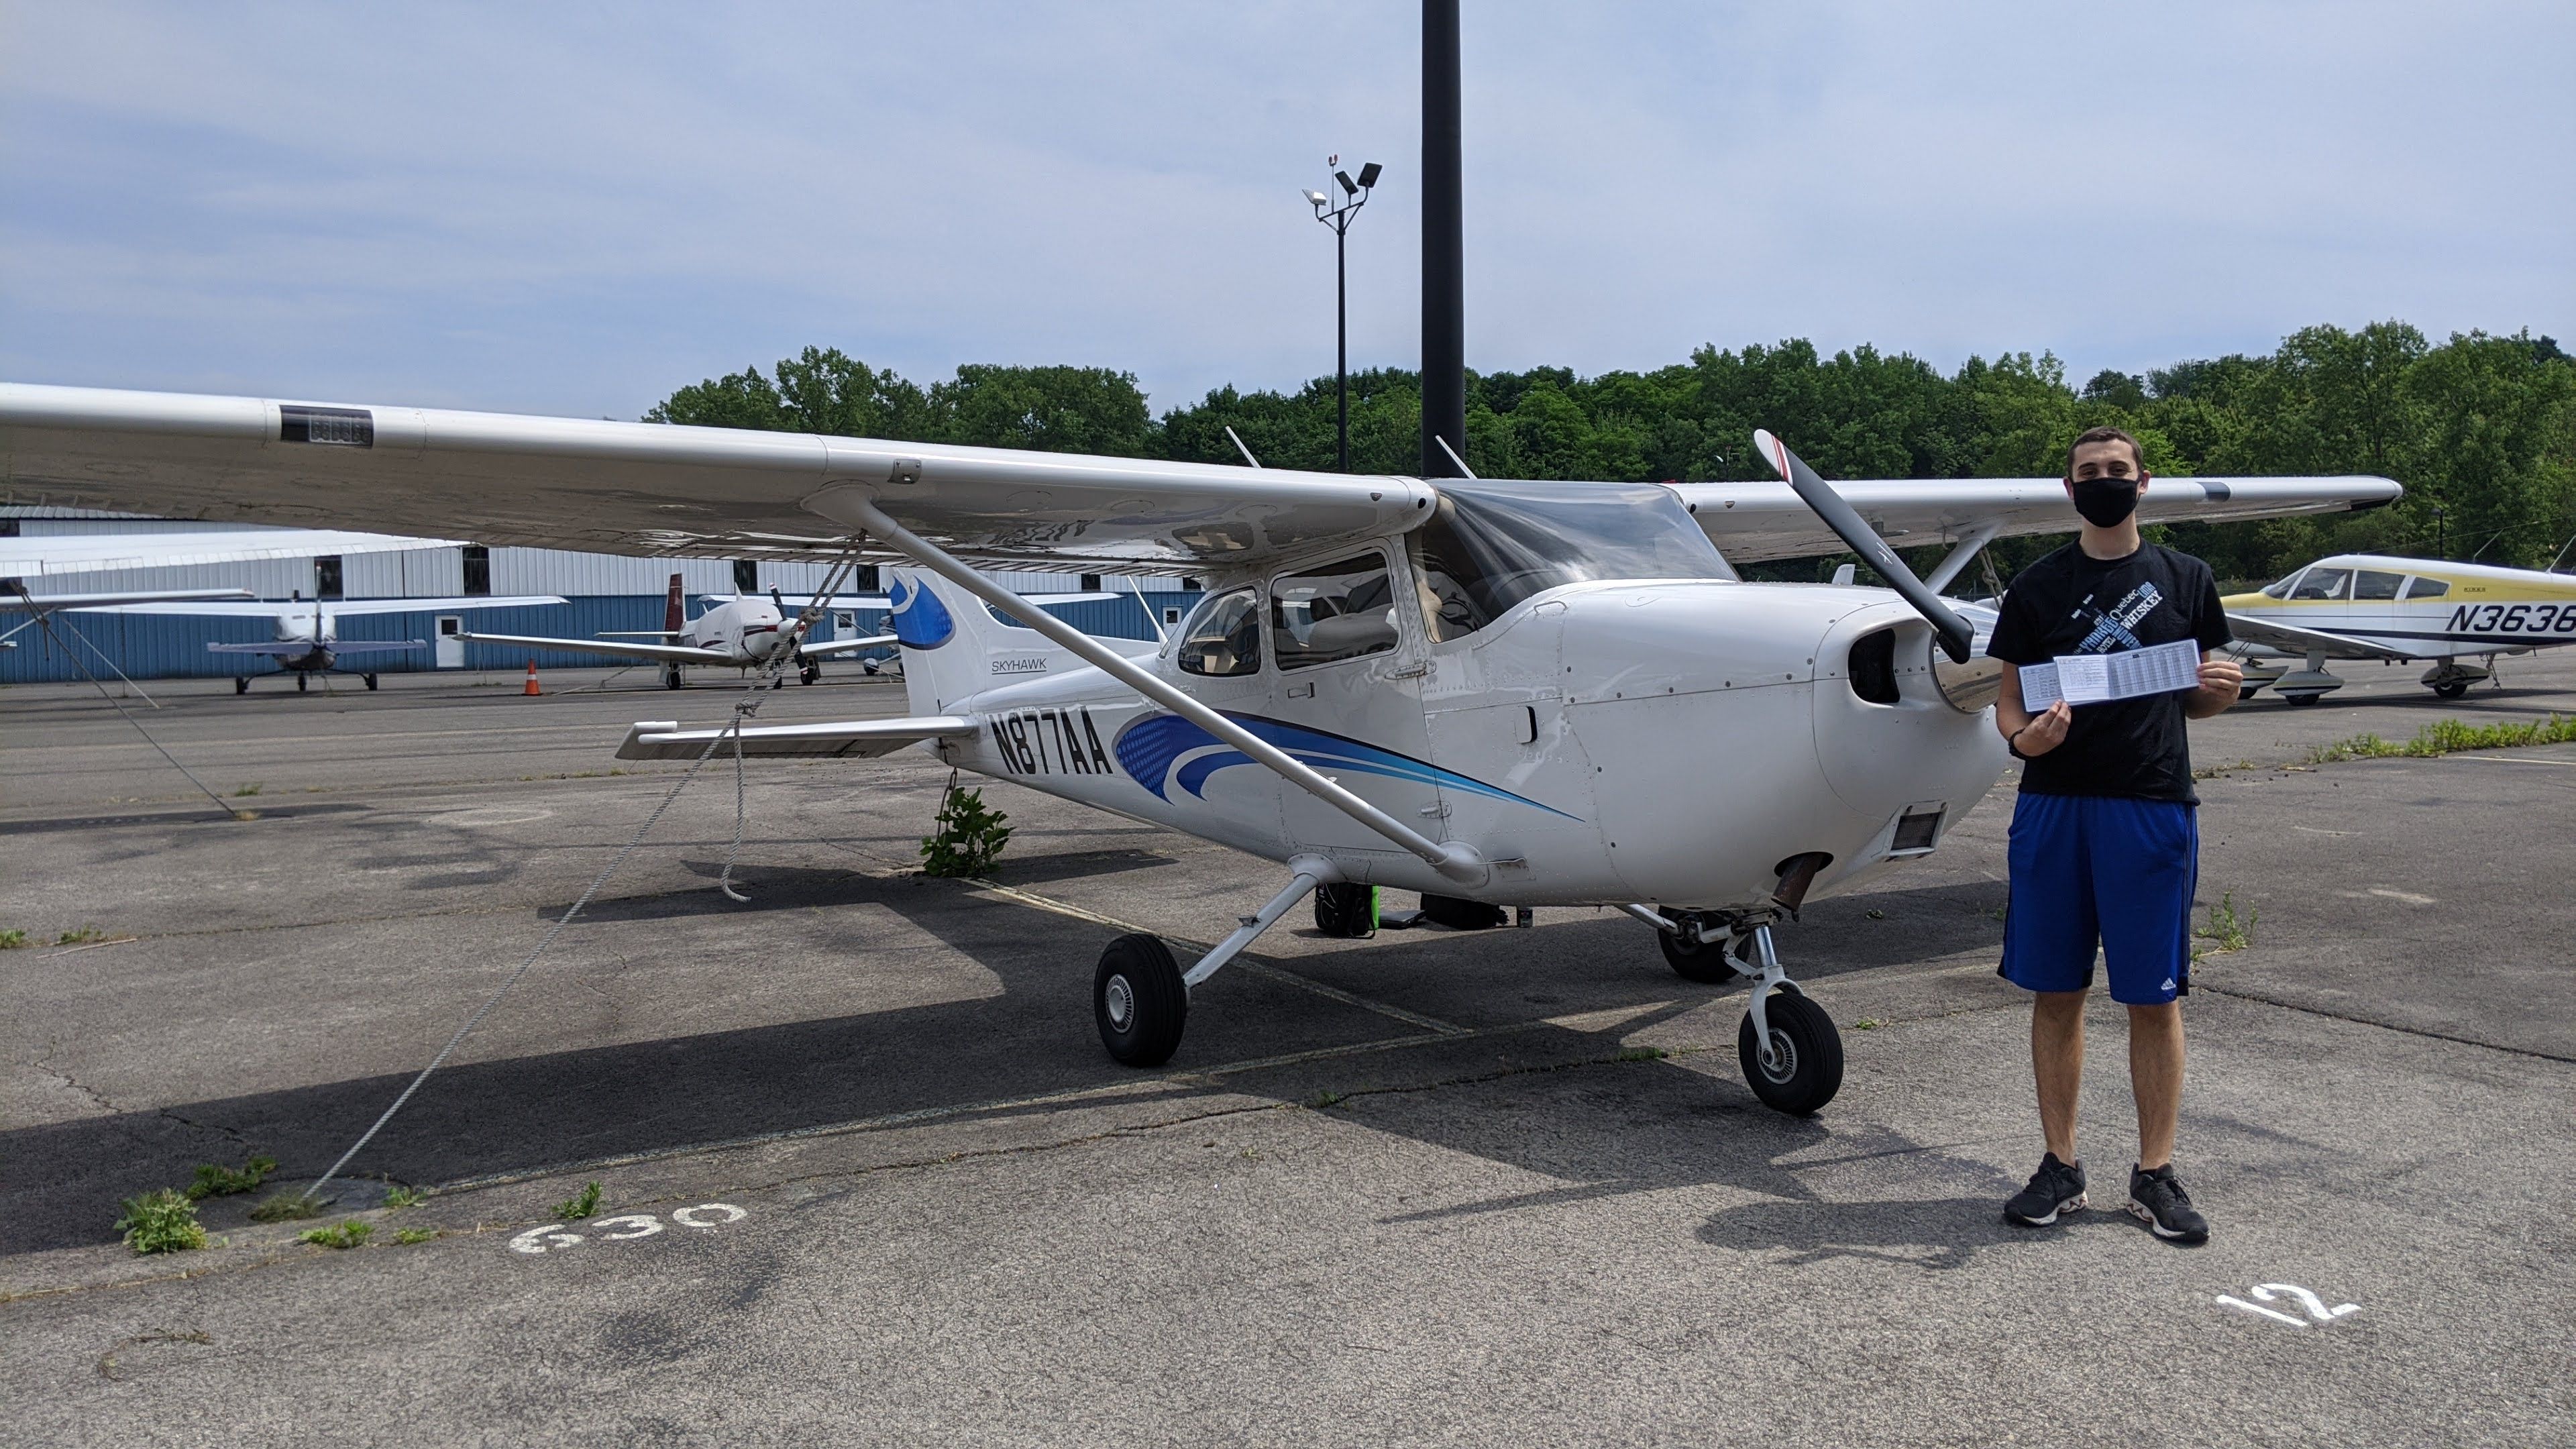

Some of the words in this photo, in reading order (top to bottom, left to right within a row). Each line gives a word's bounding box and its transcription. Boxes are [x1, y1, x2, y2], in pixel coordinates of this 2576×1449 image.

[2109, 589, 2139, 621] Quebec
[2121, 590, 2163, 629] WHISKEY
[2445, 605, 2576, 632] N3636
[2079, 617, 2119, 651] YANKEE
[2096, 636, 2116, 653] HOTEL
[992, 658, 1046, 672] SKYHAWK
[989, 706, 1114, 774] N877AA
[508, 1203, 748, 1254] 630
[2216, 1283, 2362, 1327] 12
